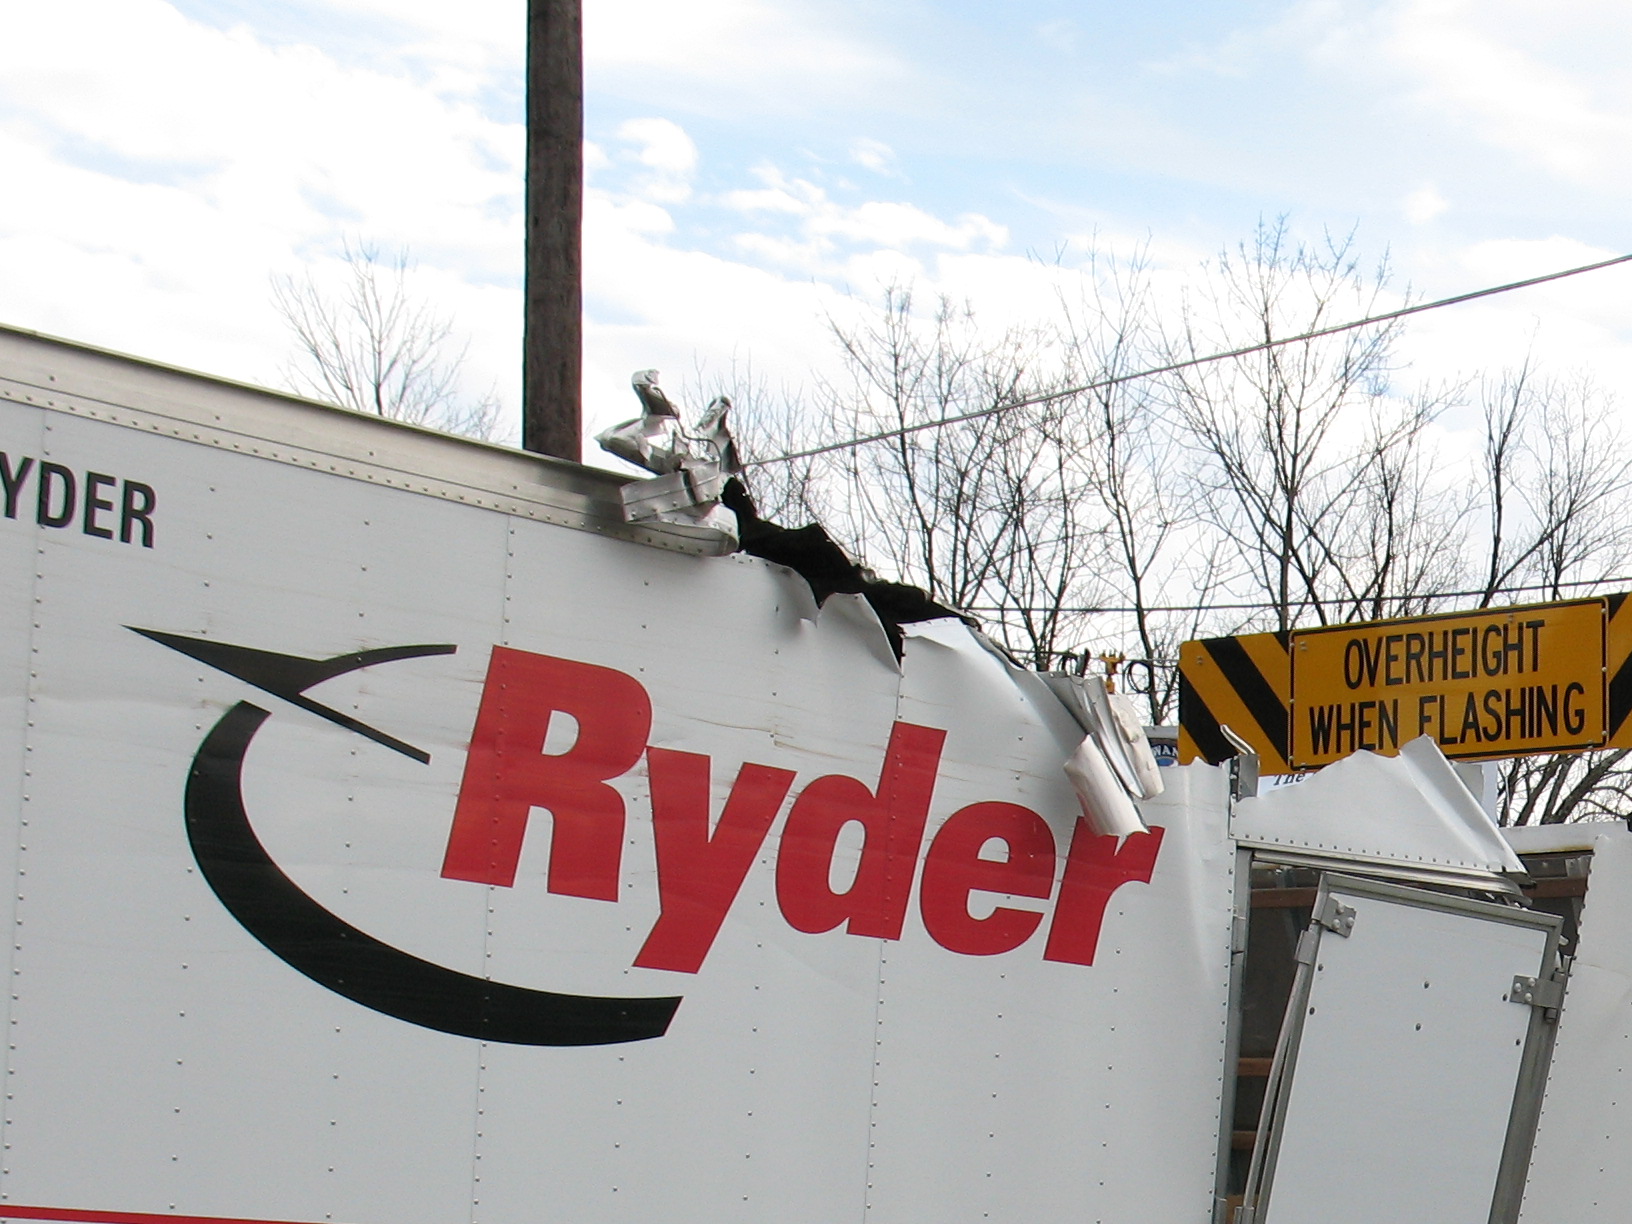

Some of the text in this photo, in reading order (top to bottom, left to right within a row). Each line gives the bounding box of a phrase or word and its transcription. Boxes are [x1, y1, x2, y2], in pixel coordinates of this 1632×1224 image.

[1344, 620, 1545, 690] OVERHEIGHT
[1309, 682, 1586, 755] WHEN FLASHING
[440, 645, 1164, 974] Ryder
